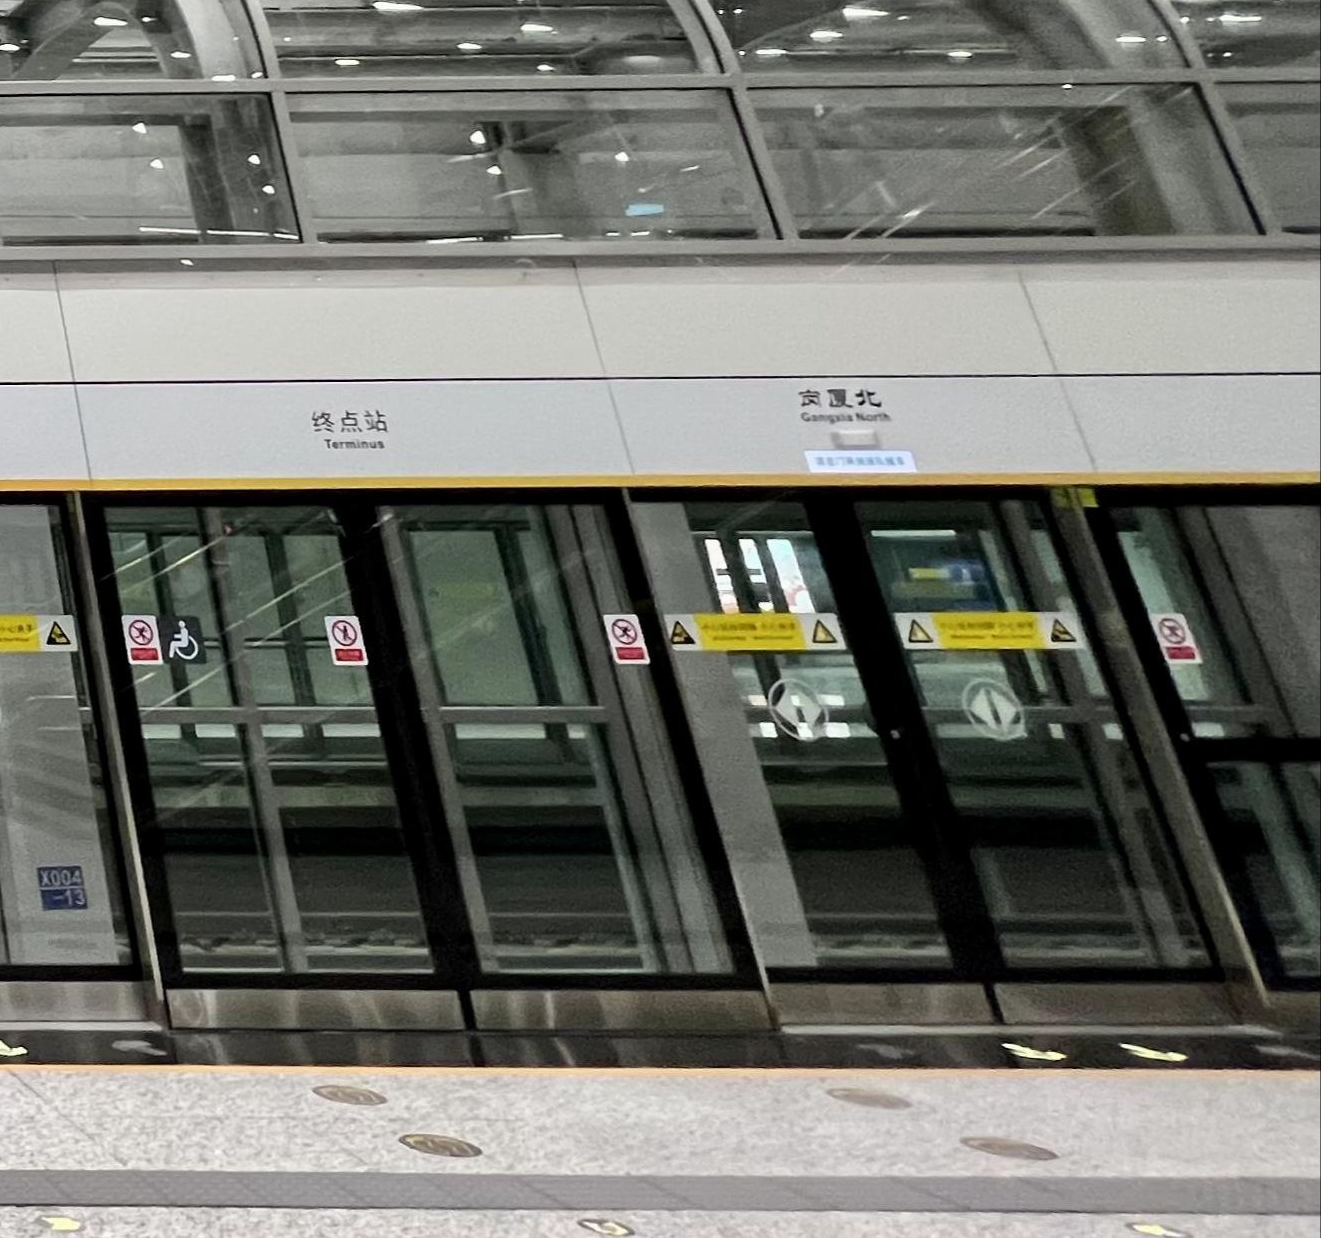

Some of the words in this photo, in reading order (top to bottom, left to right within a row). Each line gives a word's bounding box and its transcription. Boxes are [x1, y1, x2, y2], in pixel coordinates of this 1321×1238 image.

[798, 388, 883, 409] 岗厦北
[311, 409, 388, 433] 终点站
[324, 438, 386, 450] Terminus
[40, 868, 82, 887] X004
